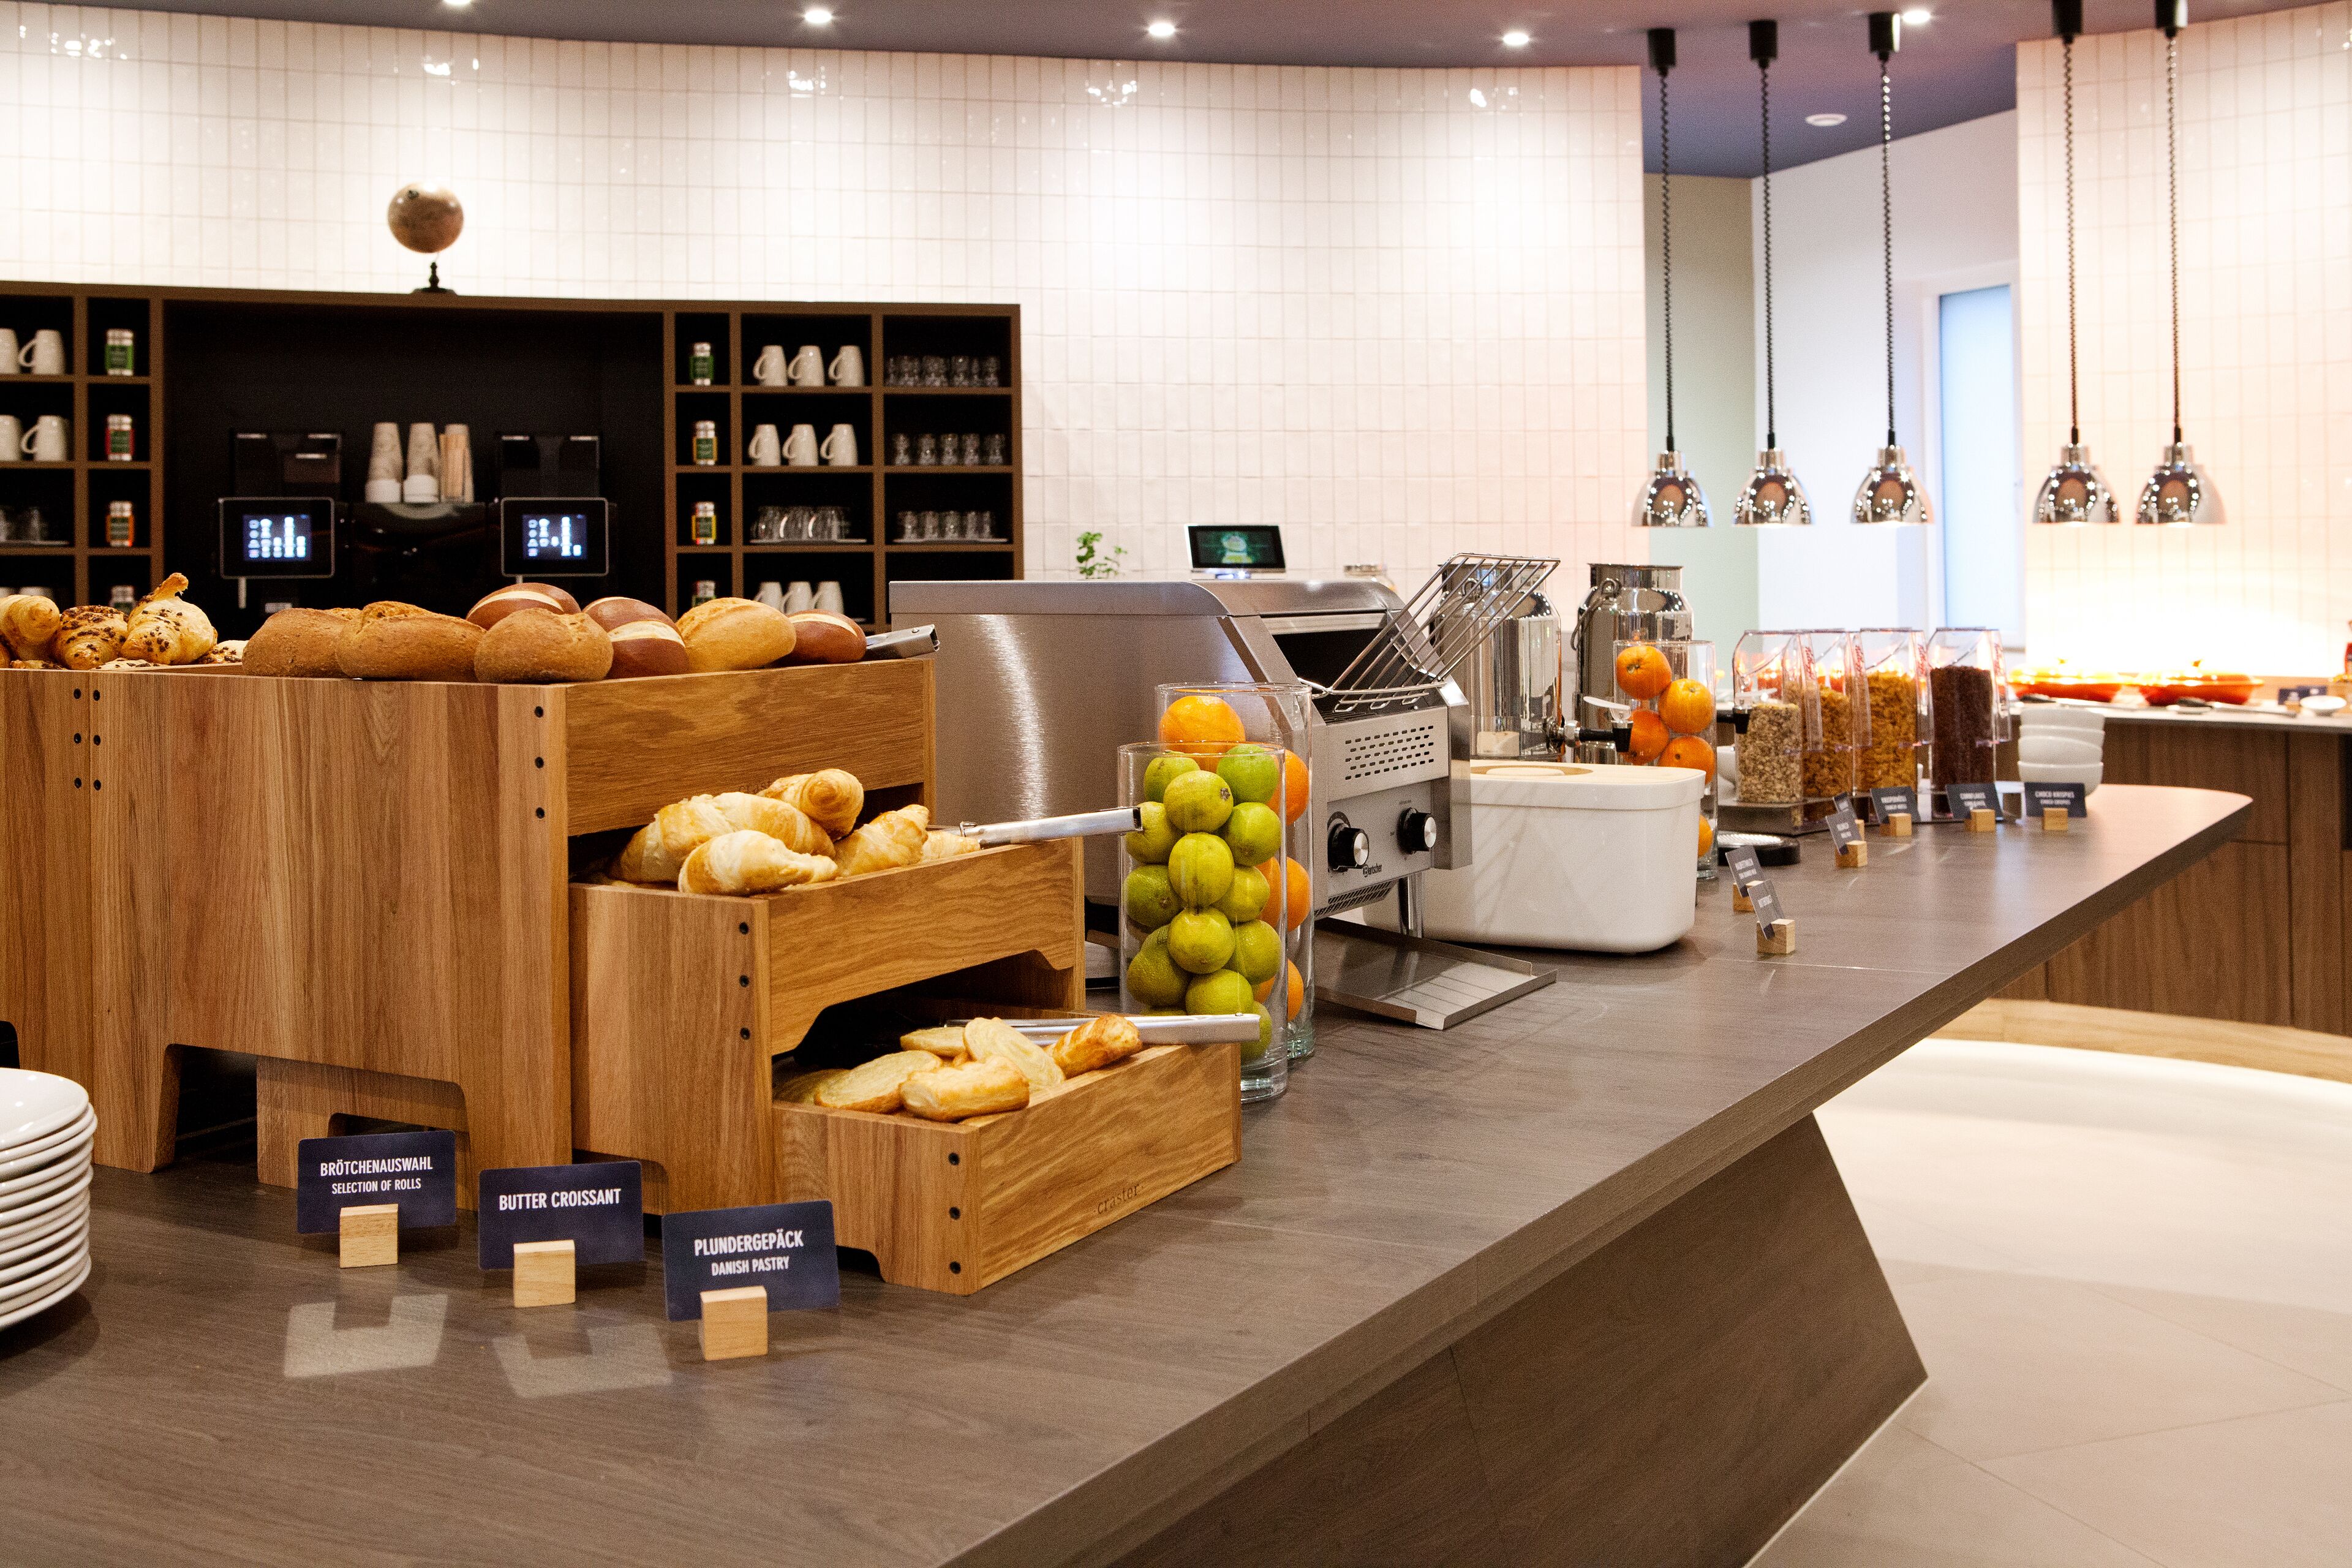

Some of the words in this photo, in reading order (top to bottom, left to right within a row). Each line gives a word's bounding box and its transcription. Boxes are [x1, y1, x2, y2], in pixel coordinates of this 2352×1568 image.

[320, 1156, 433, 1177] BRÖTCHENAUSWAHL
[331, 1180, 379, 1194] SELECTION
[380, 1180, 392, 1191] OF
[394, 1178, 421, 1190] ROLLS
[499, 1193, 548, 1211] BUTTER
[551, 1188, 621, 1208] CROISSANT
[1097, 1183, 1140, 1215] craster
[694, 1228, 804, 1256] PLUNDERGEPÄCK
[711, 1259, 750, 1276] DANISH
[752, 1256, 790, 1273] PASTRY
